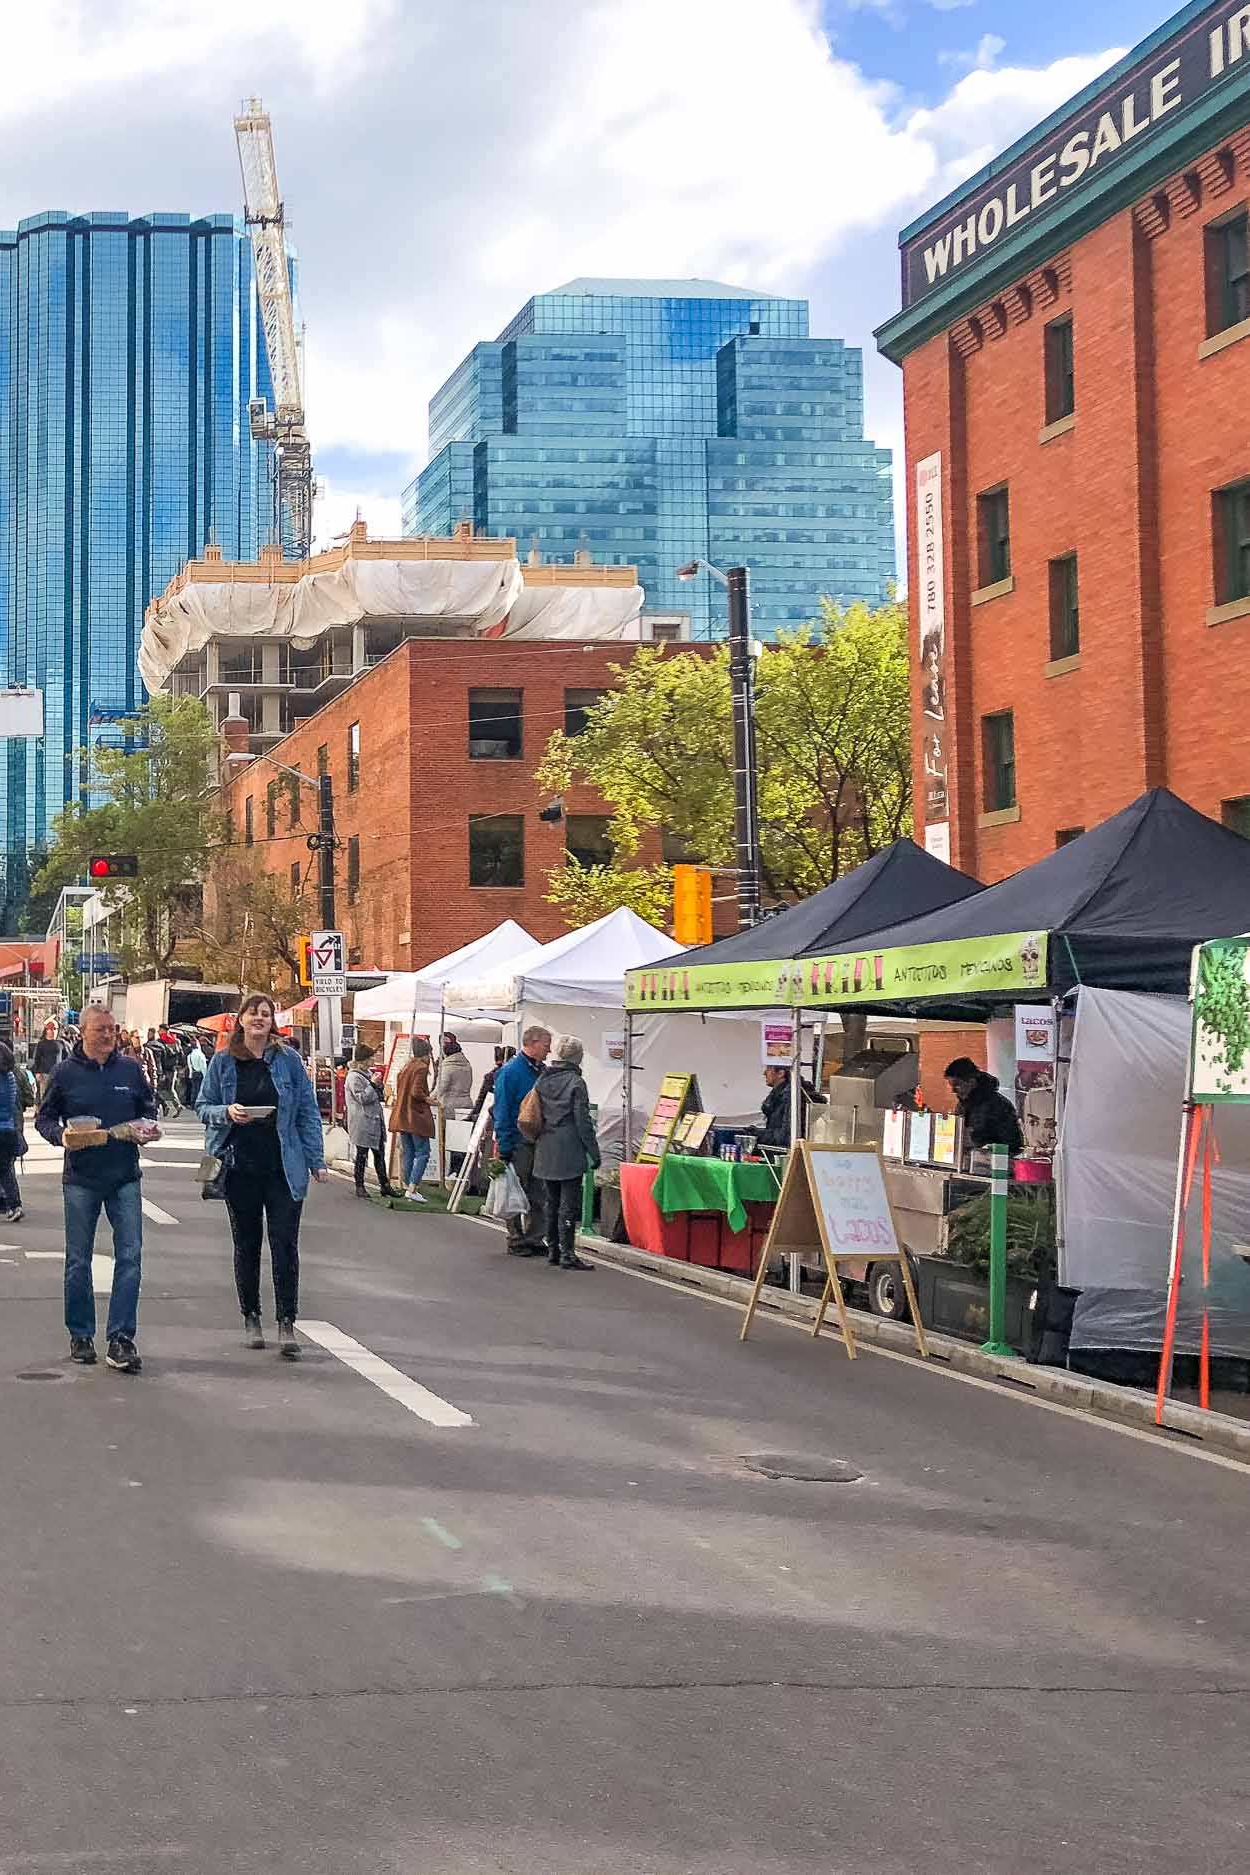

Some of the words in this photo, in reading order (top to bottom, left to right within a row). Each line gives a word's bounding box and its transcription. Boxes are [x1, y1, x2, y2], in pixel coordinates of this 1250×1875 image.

[923, 57, 1182, 284] WHOLESALE
[923, 643, 945, 721] Lease
[924, 732, 944, 777] For
[1021, 1016, 1054, 1025] tacos
